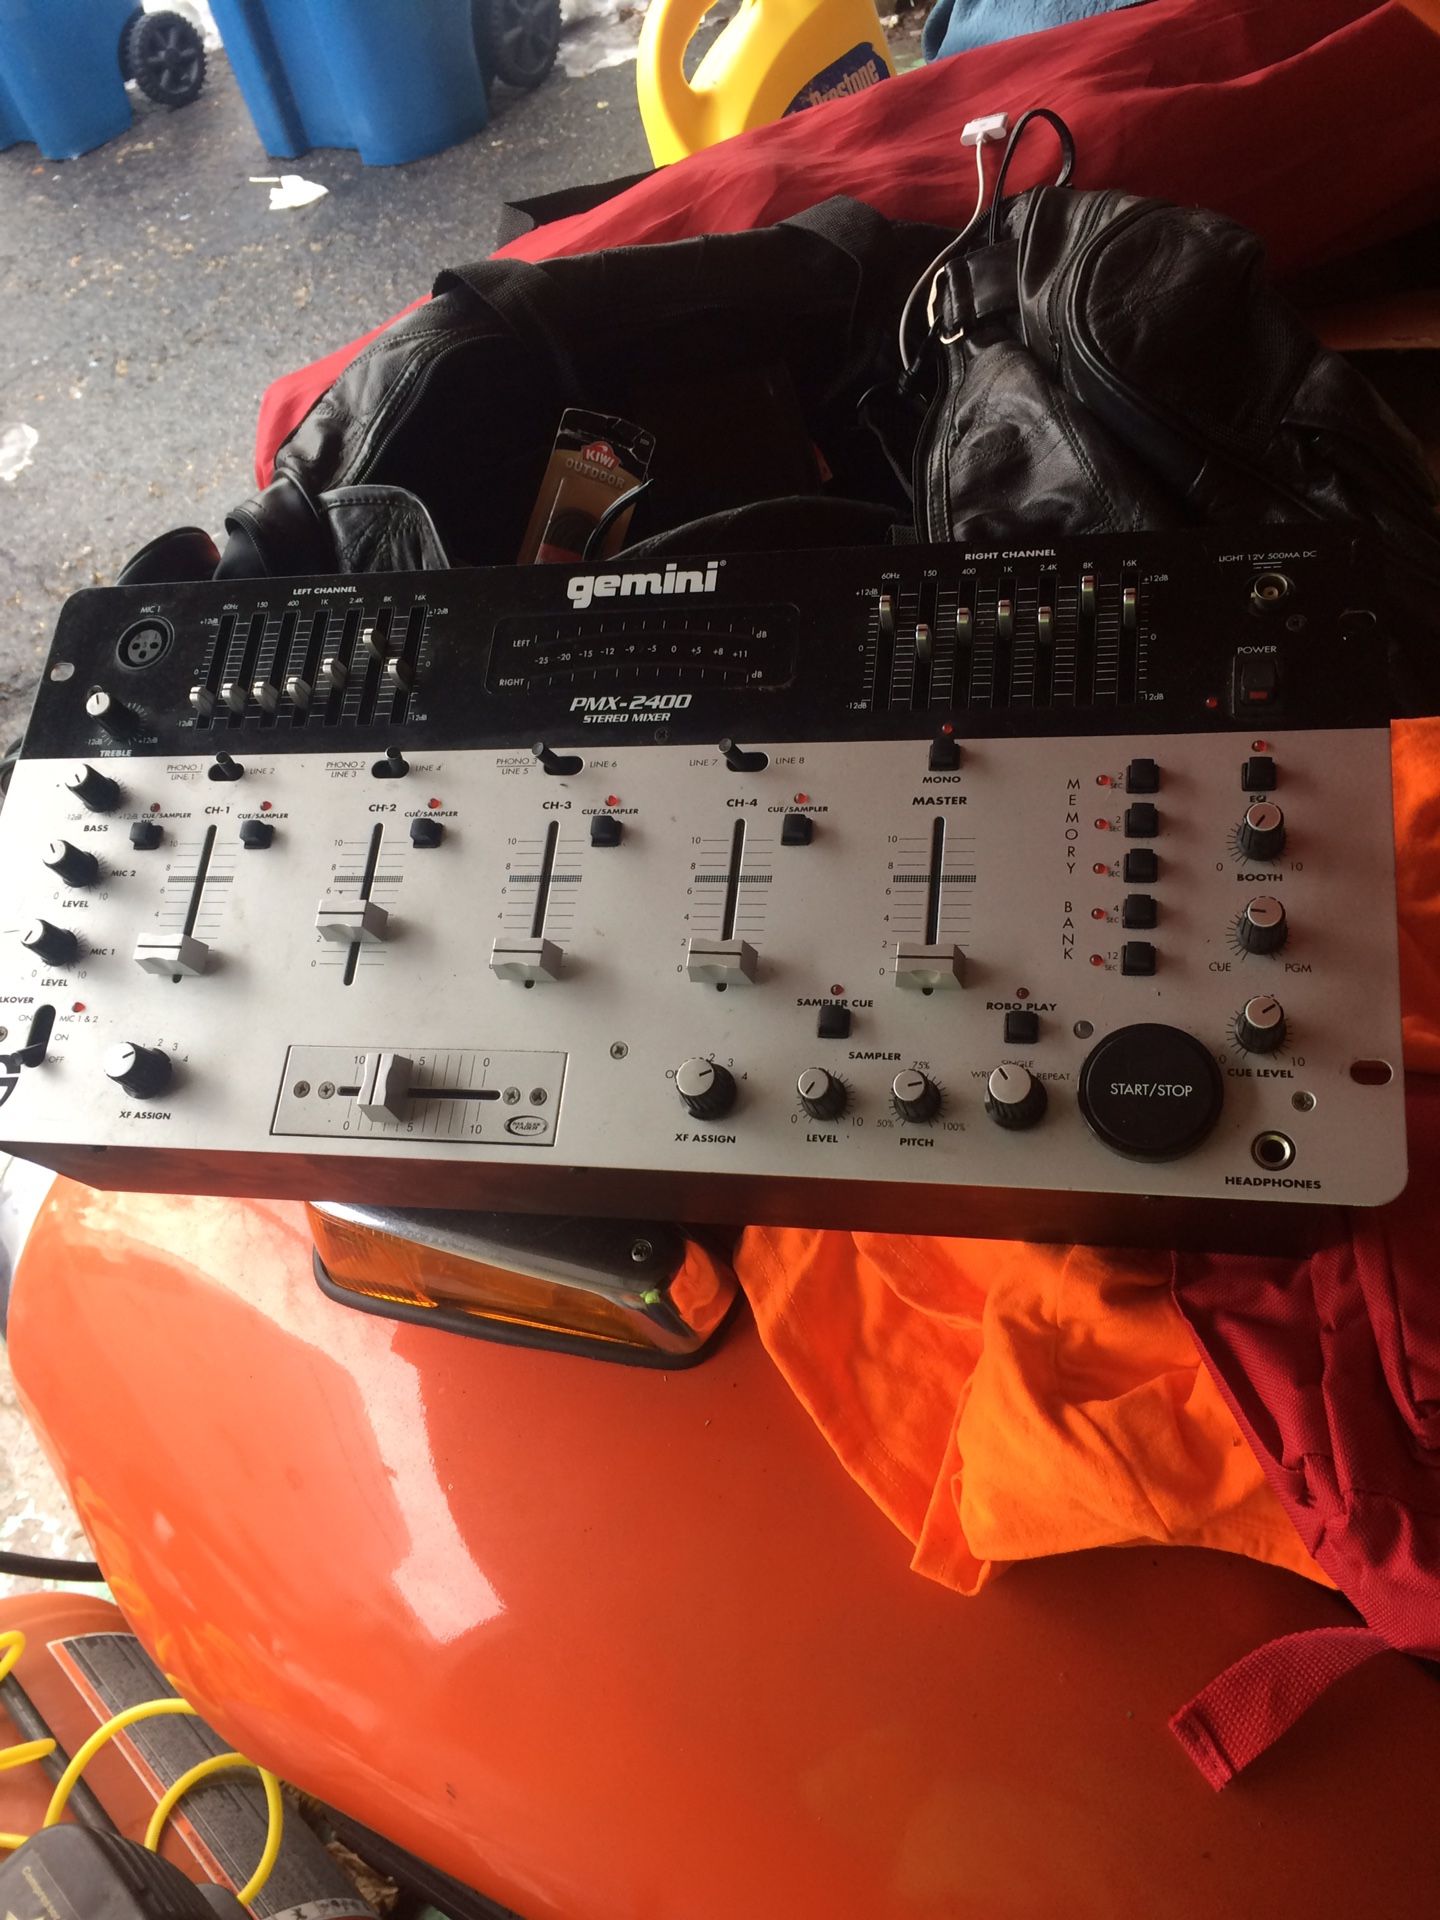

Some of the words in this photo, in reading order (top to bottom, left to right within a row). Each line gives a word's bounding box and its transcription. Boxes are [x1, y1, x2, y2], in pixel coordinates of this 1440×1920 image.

[586, 449, 614, 468] KIWI
[565, 458, 625, 489] OUTDOOR
[965, 552, 998, 561] RIGHT
[1002, 549, 1056, 558] CHANNEL
[1218, 554, 1243, 562] LIGHT
[1268, 552, 1300, 560] 500MA
[881, 572, 900, 580] 60Hz
[1122, 559, 1137, 567] 16K
[566, 561, 719, 609] gemini
[293, 588, 312, 596] LEFT
[314, 586, 357, 594] CHANNEL
[756, 630, 767, 639] dB
[512, 639, 530, 648] LEFT
[534, 656, 549, 664] -25
[556, 653, 571, 662] -20
[578, 650, 593, 658] -15
[600, 648, 615, 656] -12
[625, 645, 635, 654] -9
[648, 644, 657, 652] -5
[671, 645, 677, 653] 0
[691, 646, 701, 654] +5
[713, 648, 724, 656] +8
[733, 650, 748, 658] +11
[1237, 645, 1277, 654] POWER
[751, 670, 762, 678] dB
[499, 678, 524, 687] RIGHT
[569, 694, 692, 711] PMX-2400
[583, 714, 628, 724] STEREO
[631, 712, 671, 722] MIXER
[100, 749, 132, 757] TREBLE
[590, 760, 609, 768] LINE
[612, 760, 618, 768] 6
[689, 758, 709, 766] LINE
[712, 758, 718, 766] 7
[775, 756, 796, 764] LINE
[799, 756, 805, 764] 8
[167, 764, 198, 772] PHONO
[416, 764, 434, 772] LINE
[542, 801, 572, 810] CH-3
[726, 798, 758, 808] CH-4
[912, 796, 967, 806] MASTER
[205, 806, 230, 815] CH-1
[368, 803, 397, 812] CH-2
[1065, 779, 1080, 874] MEMORY
[691, 836, 701, 844] 10
[887, 835, 898, 843] 10
[505, 862, 511, 870] 8
[690, 862, 696, 870] 8
[888, 862, 894, 870] 8
[1216, 862, 1224, 872] 0
[1291, 862, 1304, 872] 10
[1237, 872, 1283, 882] BOOTH
[687, 887, 692, 895] 6
[886, 888, 892, 896] 6
[62, 900, 89, 908] LEVEL
[884, 914, 890, 922] 4
[1062, 901, 1074, 960] BANK
[1107, 952, 1118, 960] 12
[676, 964, 683, 973] 0
[1208, 962, 1232, 972] CUE
[1285, 963, 1312, 973] PGM
[77, 970, 86, 979] 10
[879, 968, 885, 976] 0
[40, 978, 68, 987] LEVEL
[796, 998, 848, 1007] SAMPLER
[852, 1000, 874, 1008] CUE
[986, 1002, 1022, 1011] ROBO
[1026, 1003, 1057, 1012] PLAY
[848, 1051, 902, 1060] SAMPLER
[354, 1056, 366, 1065] 10
[419, 1056, 426, 1066] 5
[483, 1058, 490, 1068] 0
[728, 1058, 734, 1067] 3
[1292, 1056, 1306, 1067] 10
[912, 1061, 930, 1070] 75%
[1036, 1072, 1070, 1080] REPEAT
[1228, 1068, 1252, 1077] CUE
[1257, 1069, 1294, 1079] LEVEL
[1110, 1082, 1193, 1098] START/STOP
[134, 1112, 171, 1120] ASSIGN
[790, 1114, 798, 1124] 0
[342, 1121, 350, 1130] 0
[852, 1117, 864, 1127] 10
[877, 1118, 894, 1128] 50%
[406, 1122, 414, 1132] 5
[470, 1124, 482, 1134] 10
[943, 1122, 966, 1132] 100%
[675, 1134, 690, 1142] XF
[692, 1134, 736, 1144] ASSIGN
[806, 1134, 838, 1143] LEVEL
[900, 1138, 934, 1148] PITCH
[1225, 1176, 1322, 1190] HEADPHONES
